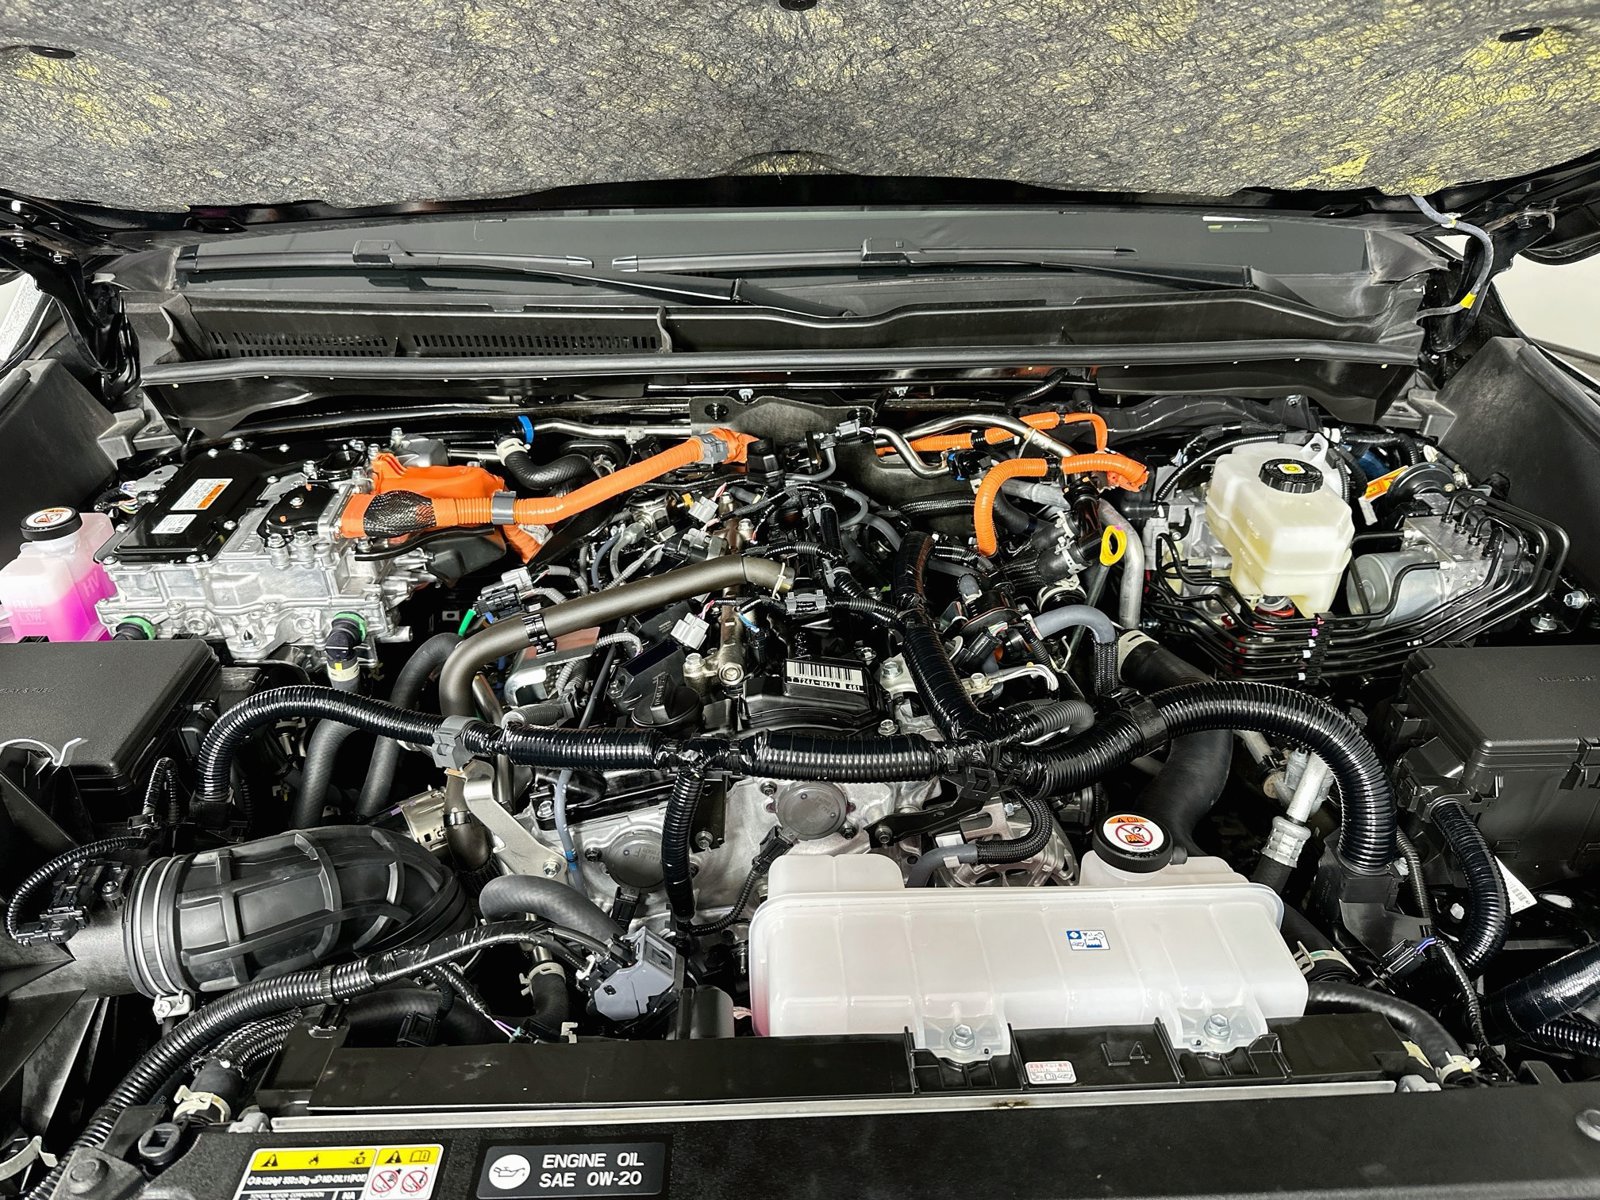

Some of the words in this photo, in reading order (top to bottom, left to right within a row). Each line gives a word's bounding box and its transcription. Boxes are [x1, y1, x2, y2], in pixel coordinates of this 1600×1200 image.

[542, 1153, 607, 1169] ENGINE
[617, 1152, 645, 1167] OIL
[538, 1172, 577, 1188] SAE
[586, 1170, 643, 1187] 0W-20
